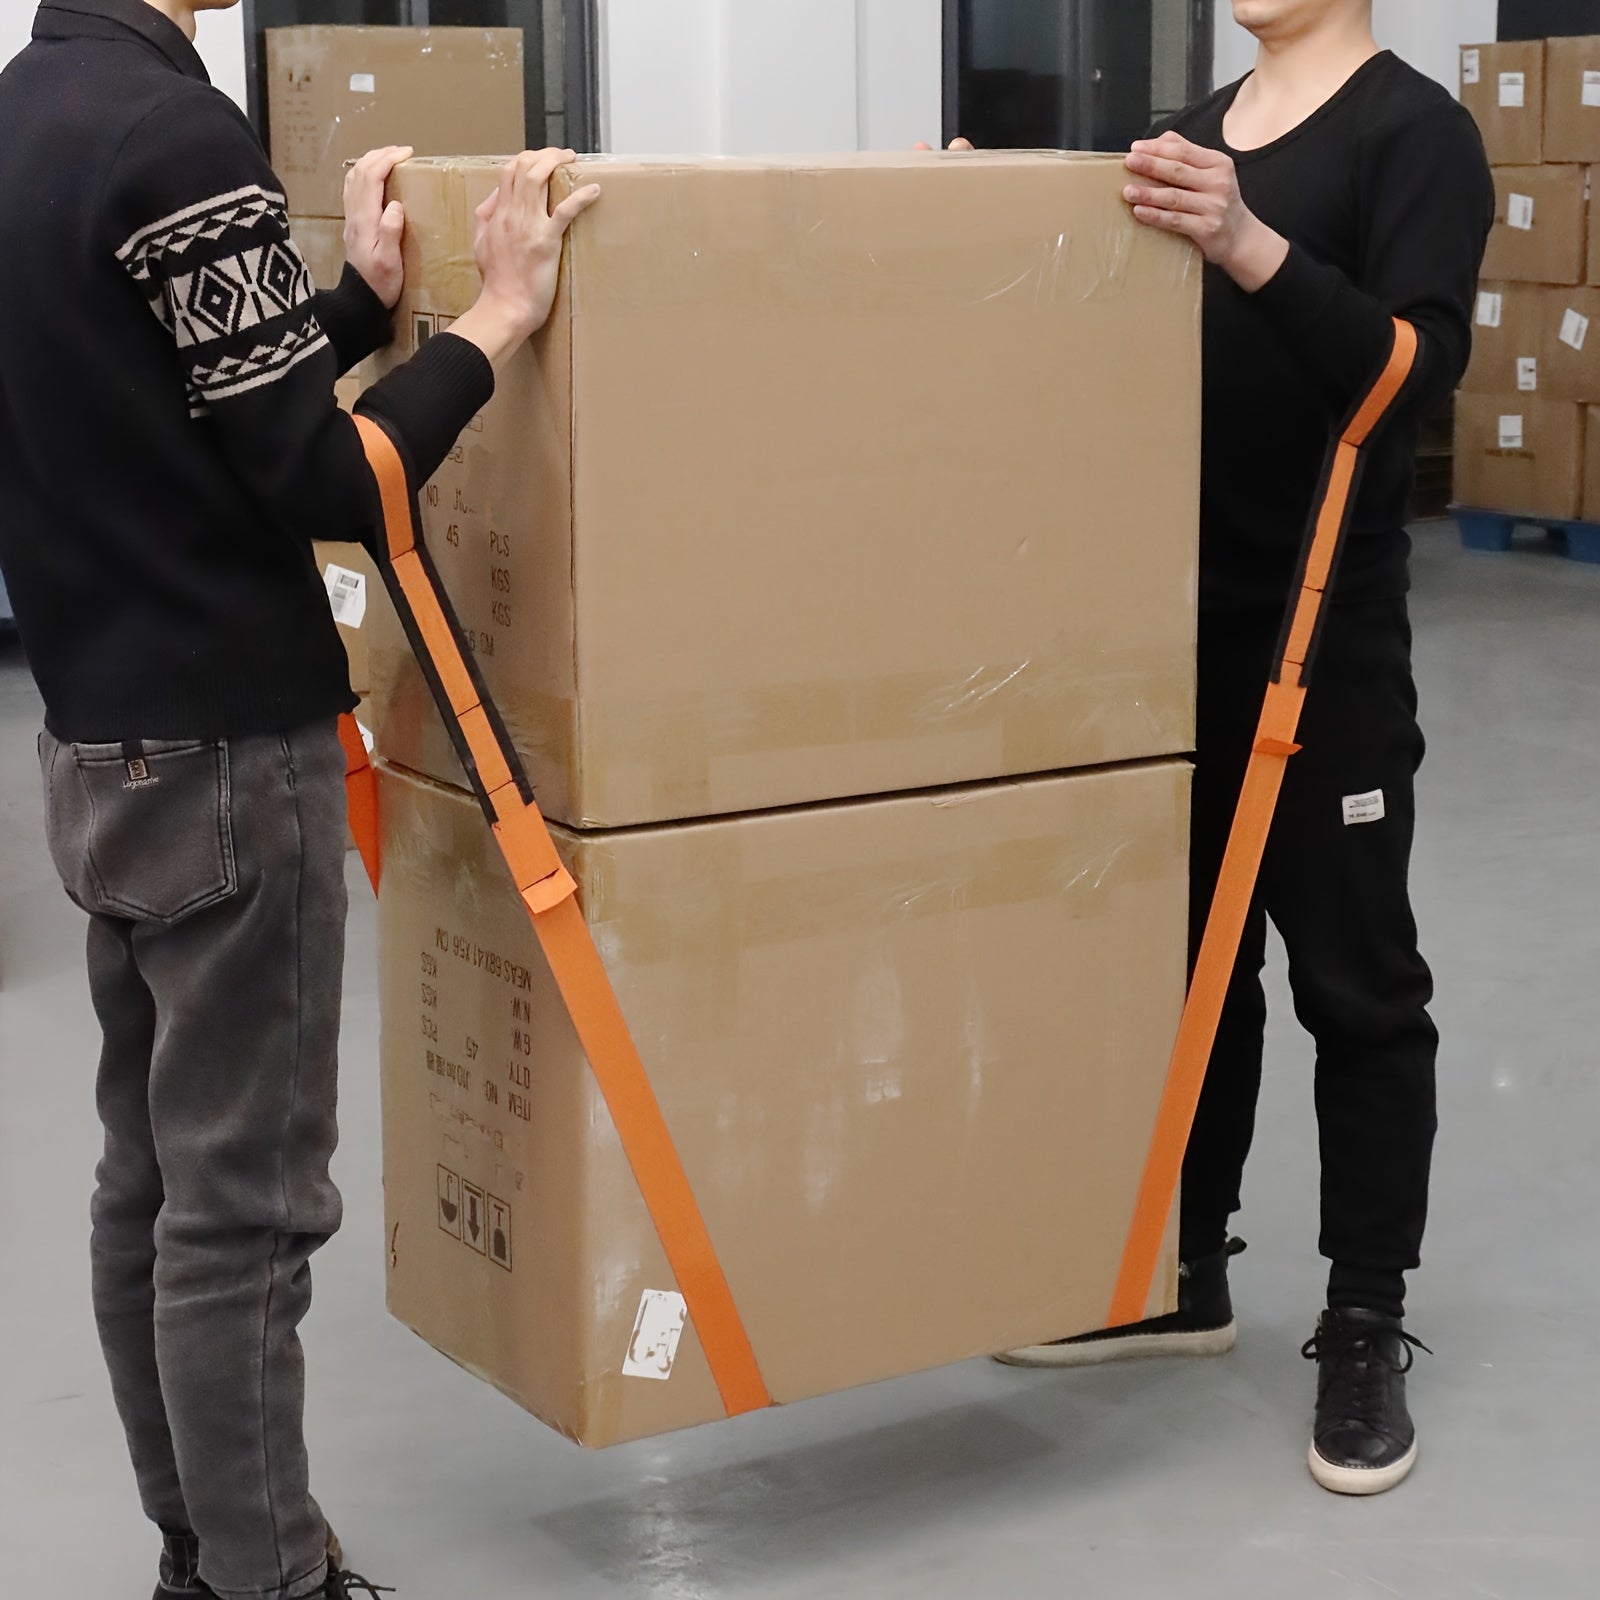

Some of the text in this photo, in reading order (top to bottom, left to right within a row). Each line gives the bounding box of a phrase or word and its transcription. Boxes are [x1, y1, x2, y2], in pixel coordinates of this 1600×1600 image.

[446, 524, 460, 548] 45
[491, 566, 511, 594] KGS
[491, 600, 512, 628] KGS
[435, 927, 449, 953] CM
[420, 951, 437, 979] KGS
[504, 959, 532, 993] MEAS
[421, 1014, 438, 1043] PCS
[466, 1035, 479, 1061] 45
[508, 1090, 531, 1122] ITEM
